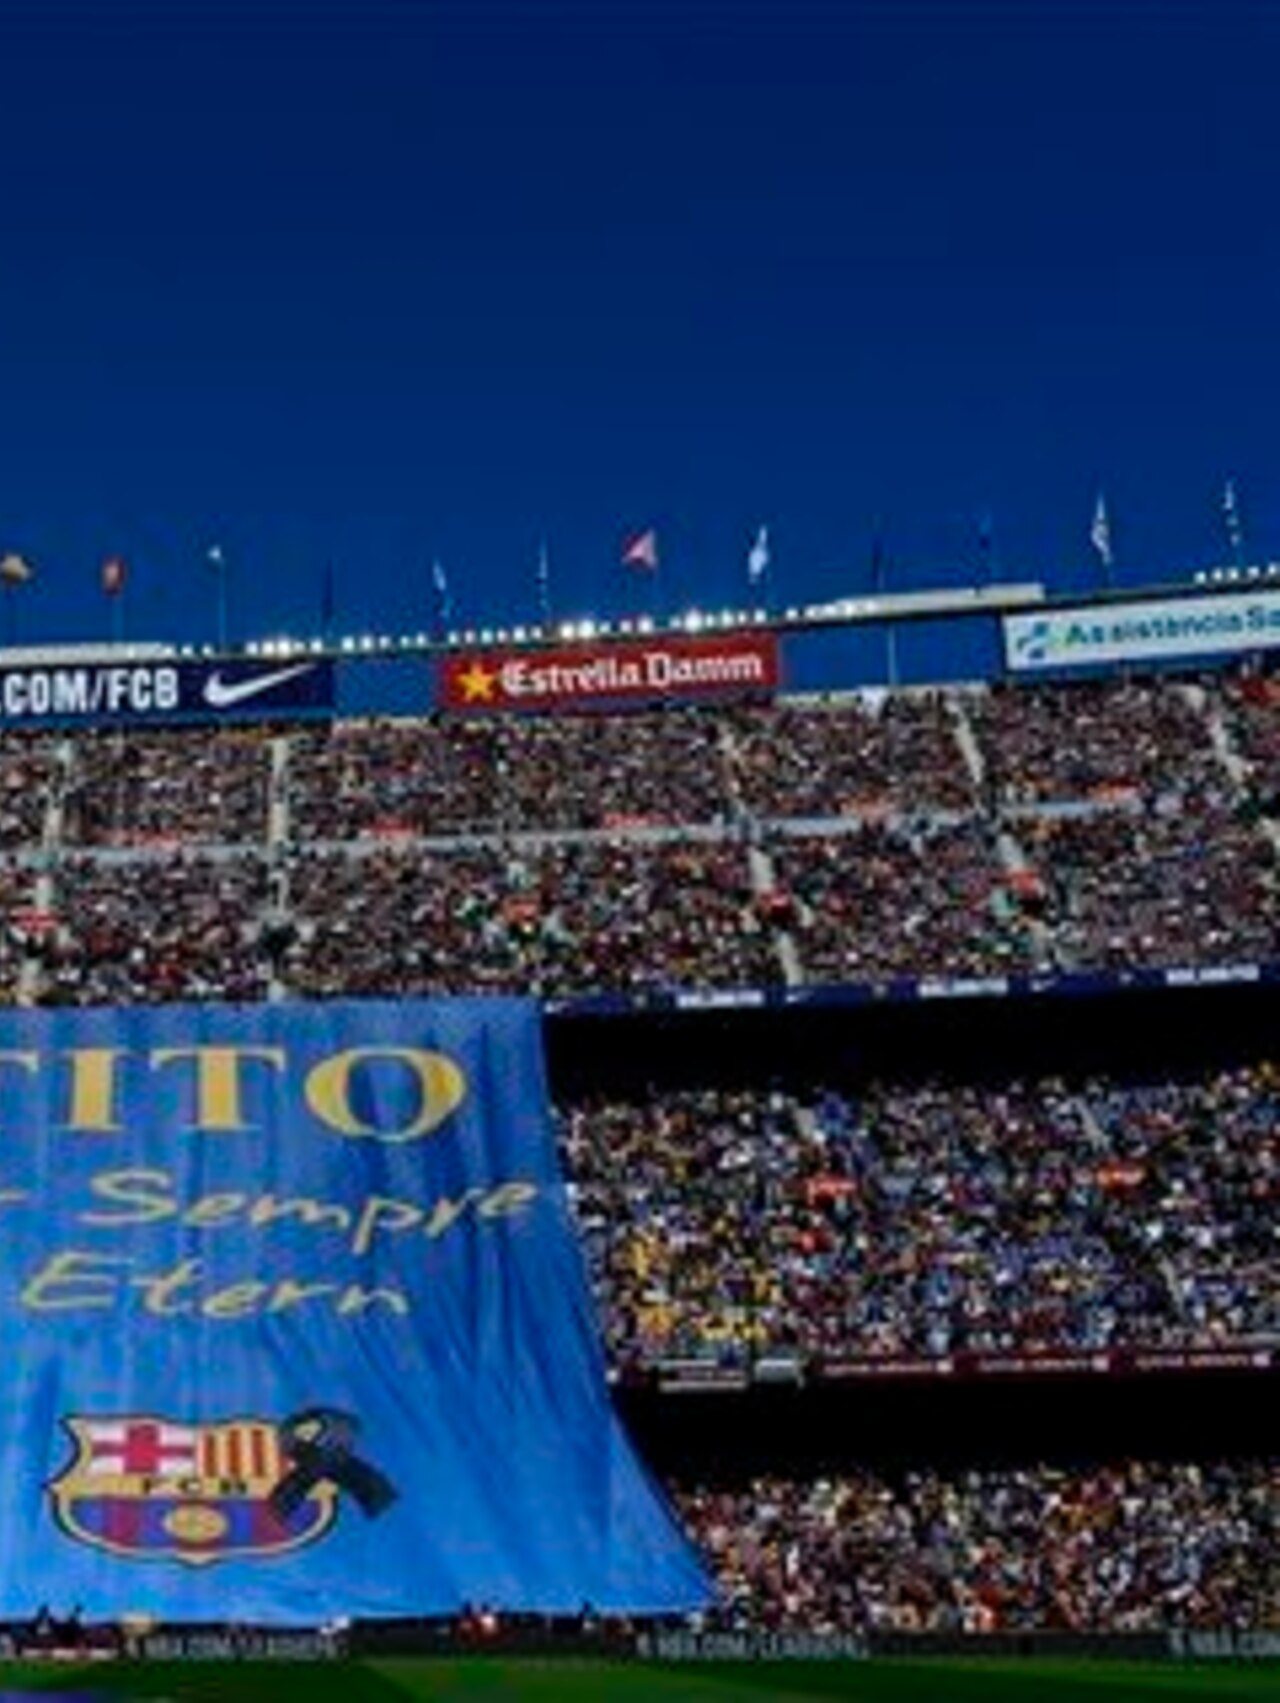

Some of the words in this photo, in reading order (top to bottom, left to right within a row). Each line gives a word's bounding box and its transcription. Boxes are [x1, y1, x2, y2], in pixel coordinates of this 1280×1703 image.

[500, 658, 639, 696] Estrella
[642, 651, 762, 687] Damm
[78, 1167, 541, 1254] Sempre
[20, 1249, 410, 1318] Etern
